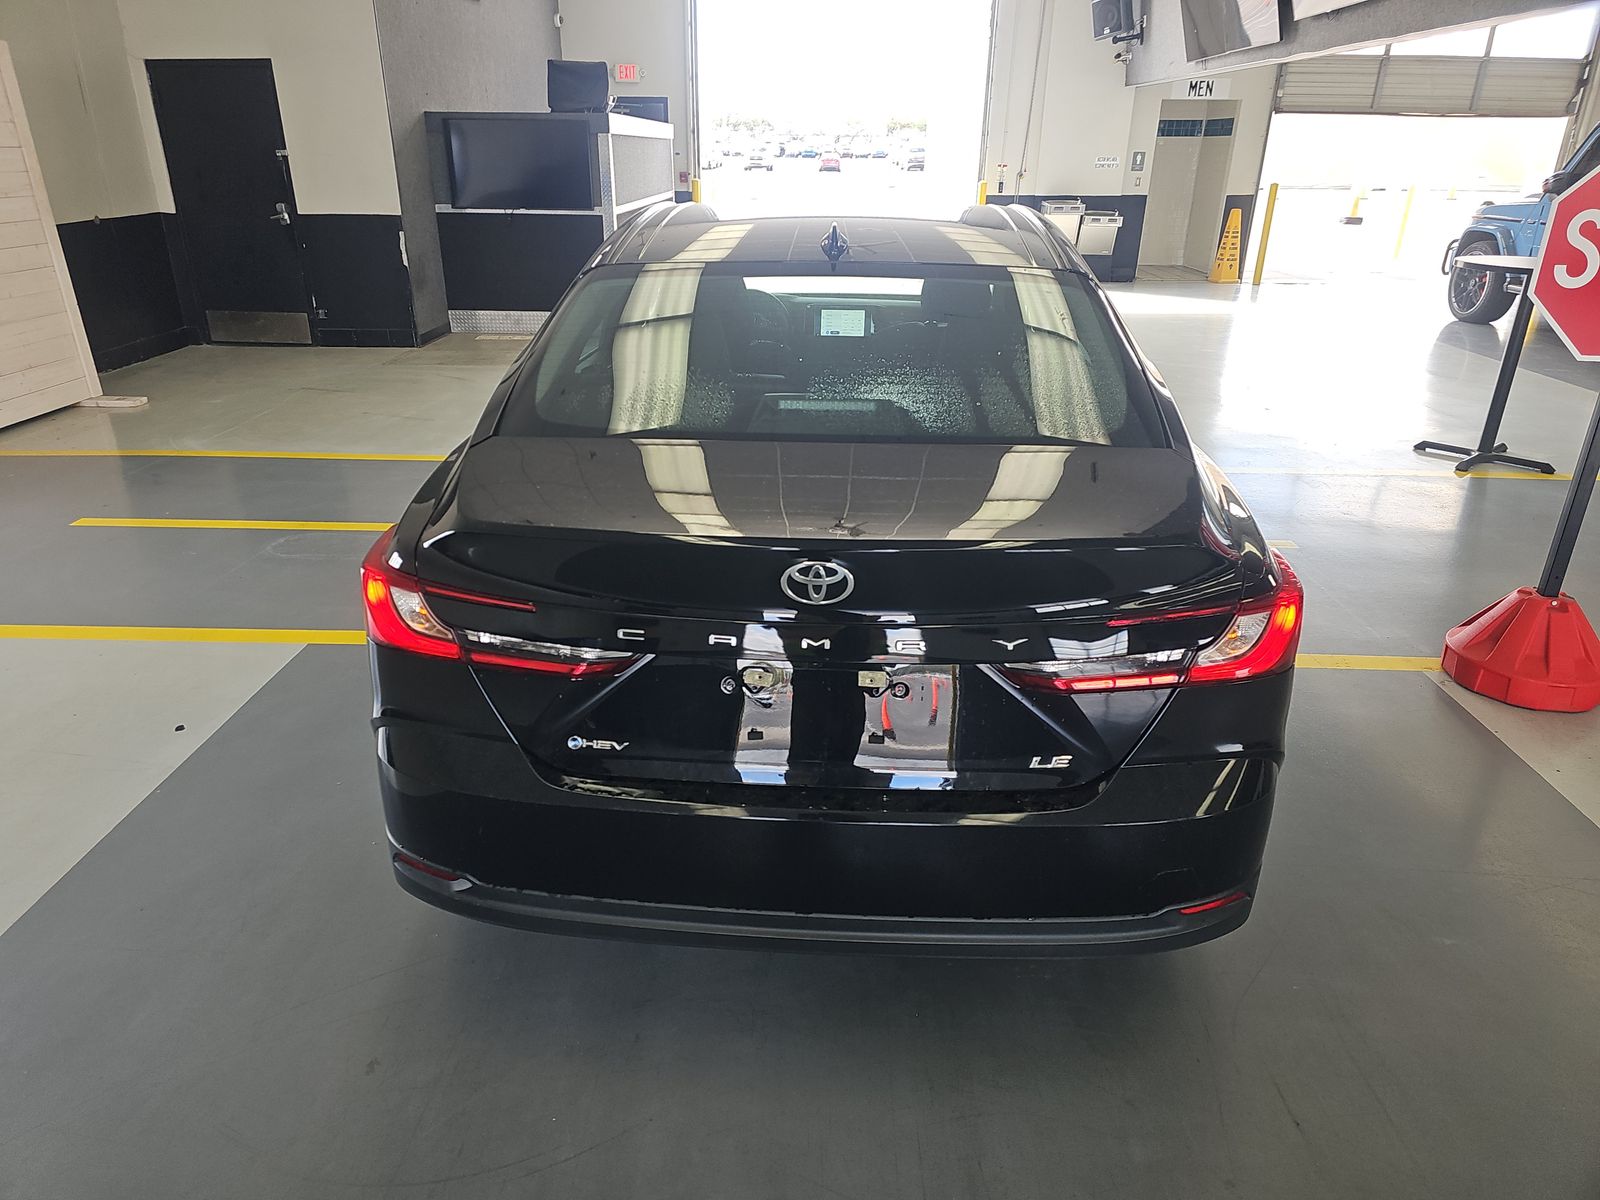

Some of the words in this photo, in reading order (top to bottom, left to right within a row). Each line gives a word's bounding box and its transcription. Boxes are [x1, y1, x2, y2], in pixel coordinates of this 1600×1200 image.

[618, 64, 636, 80] EXIT
[1187, 80, 1215, 97] MEN
[616, 628, 1029, 651] CAMRY
[581, 738, 630, 751] HEV
[1028, 755, 1073, 769] LE
